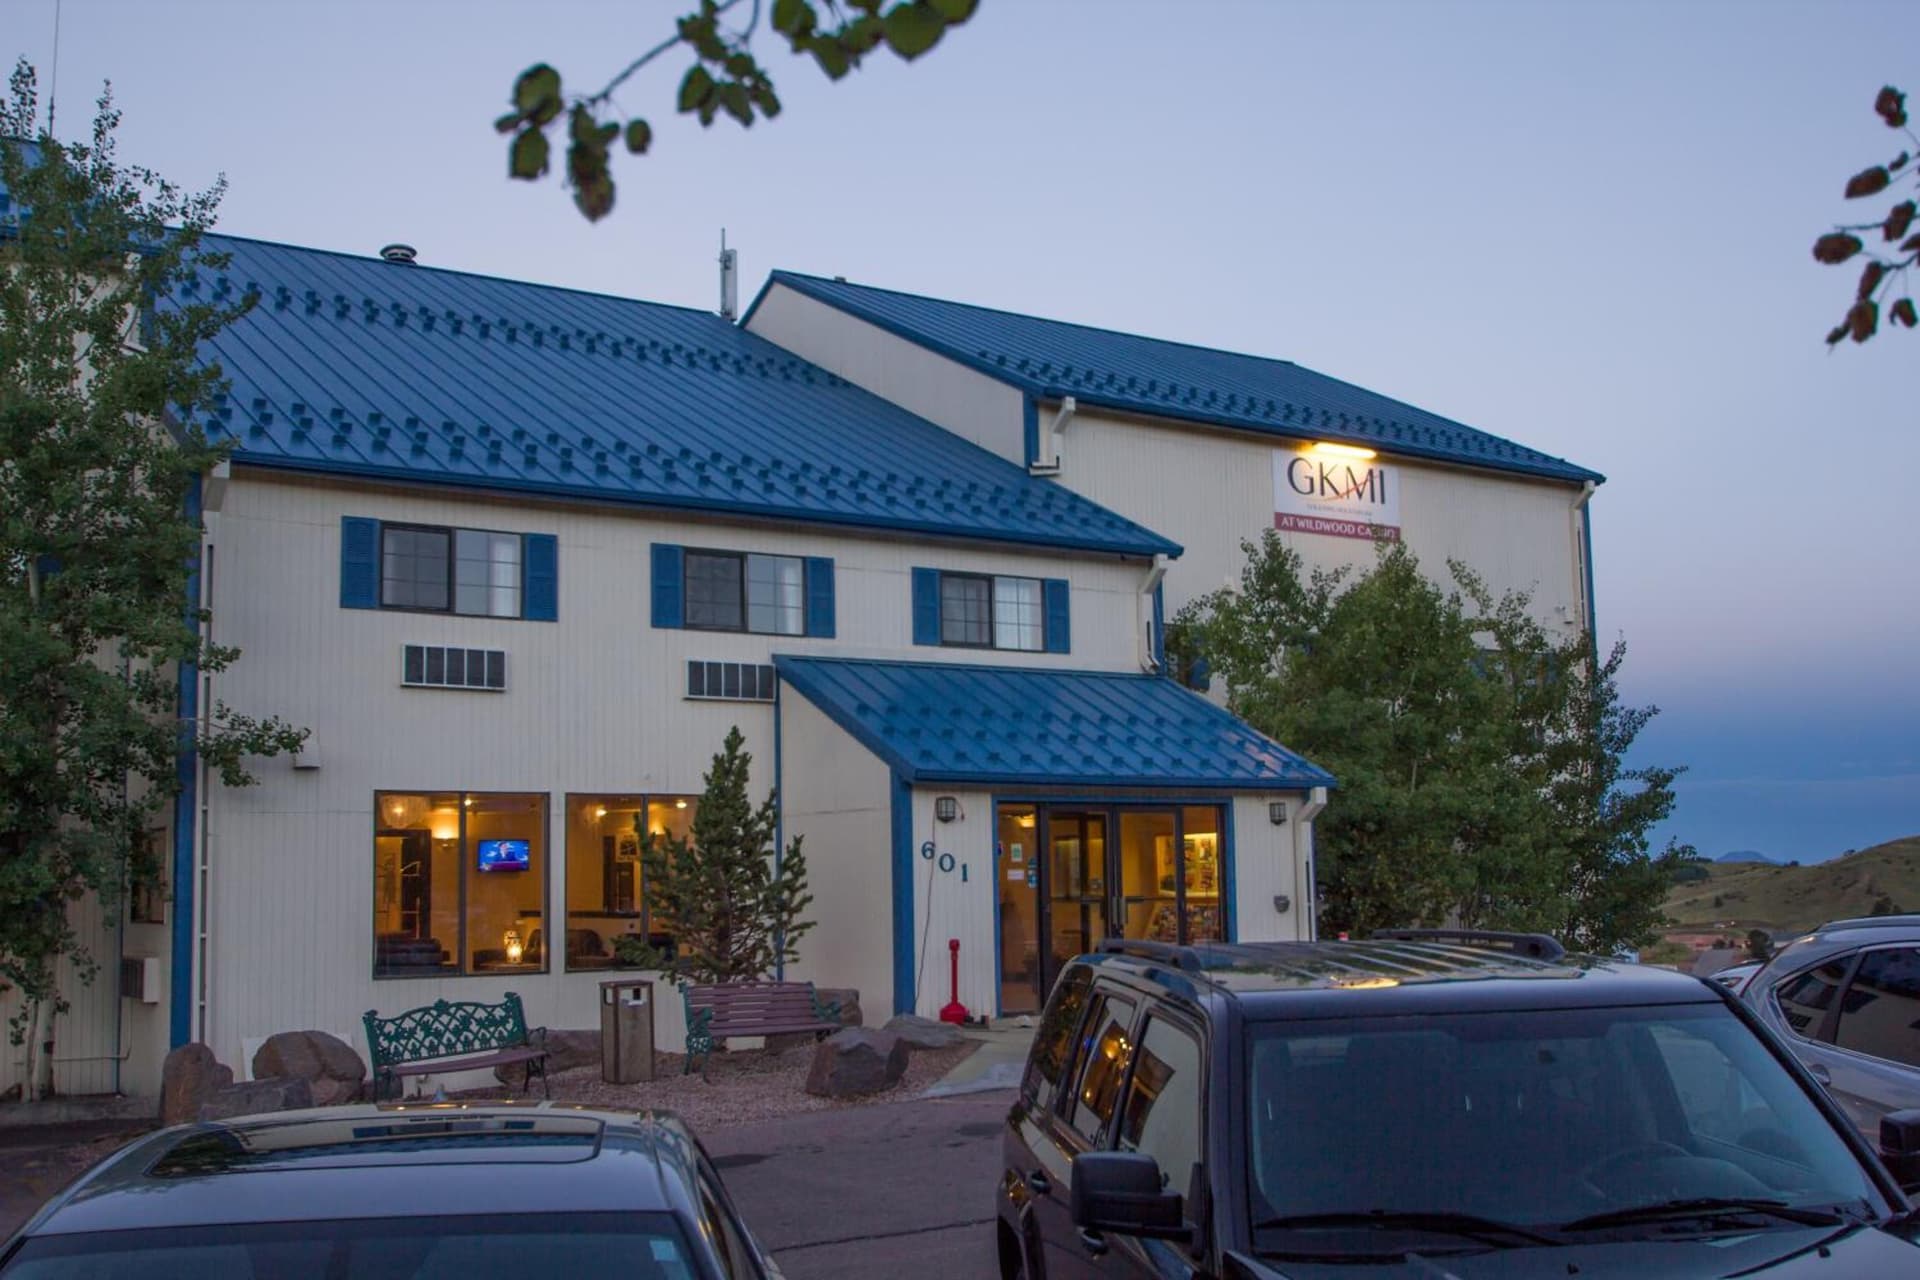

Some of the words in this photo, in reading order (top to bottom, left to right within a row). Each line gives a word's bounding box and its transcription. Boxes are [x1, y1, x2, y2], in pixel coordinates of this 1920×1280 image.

[1287, 457, 1386, 505] GKMI
[1281, 516, 1295, 528] AT
[1296, 518, 1355, 535] WILDWOOD
[921, 841, 968, 882] 601
